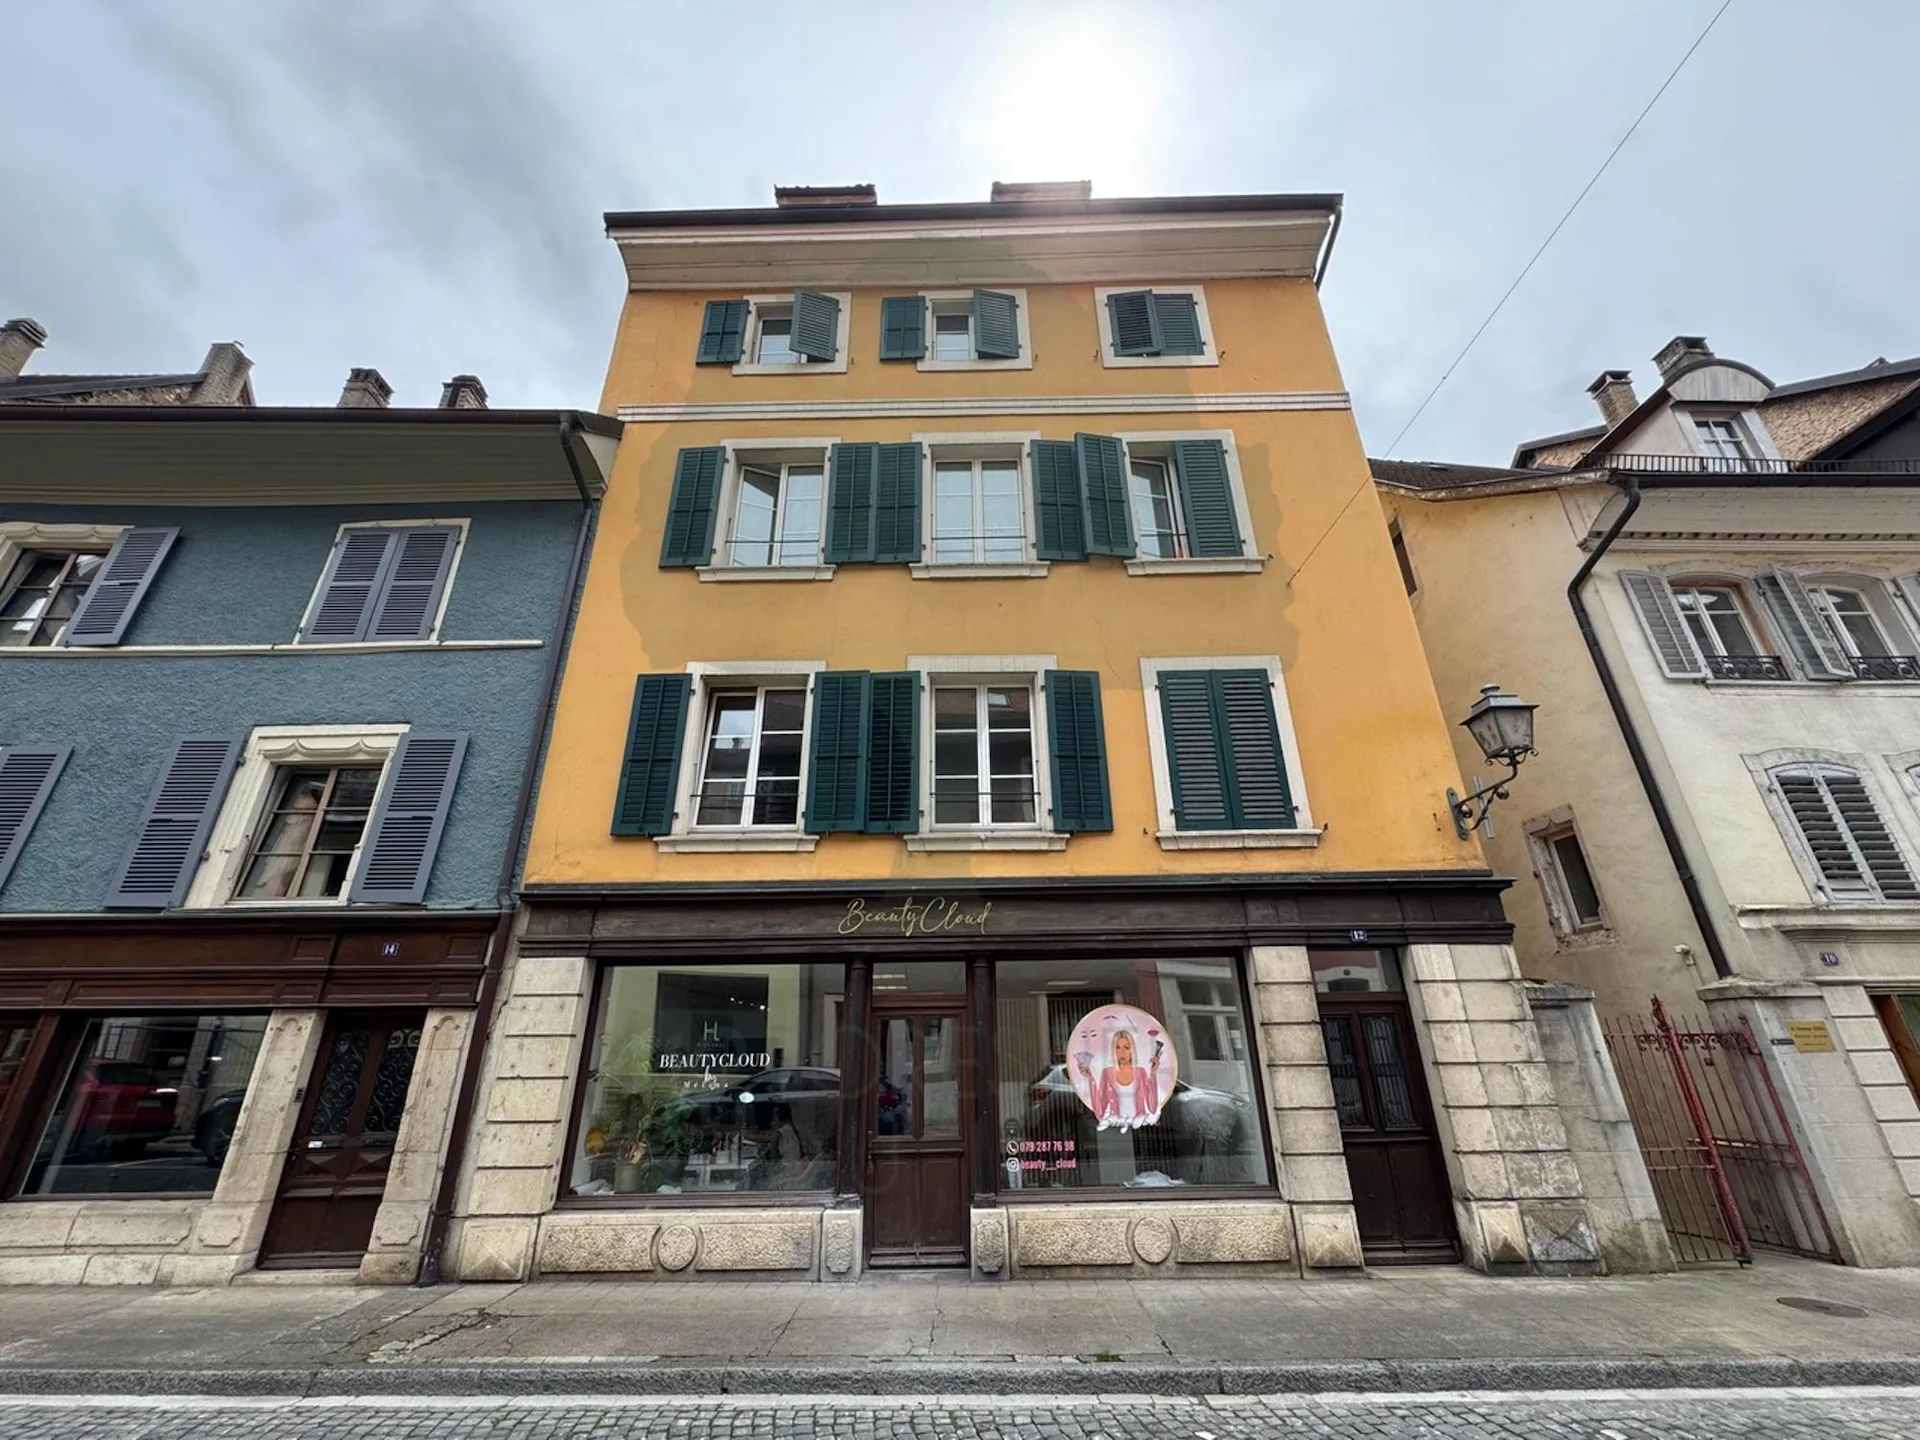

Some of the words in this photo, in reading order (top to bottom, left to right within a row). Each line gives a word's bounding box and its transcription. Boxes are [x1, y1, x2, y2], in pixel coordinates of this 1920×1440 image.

[1353, 930, 1365, 940] 12
[660, 1053, 770, 1068] BEAUTYCLOUD
[1052, 1140, 1063, 1152] 76
